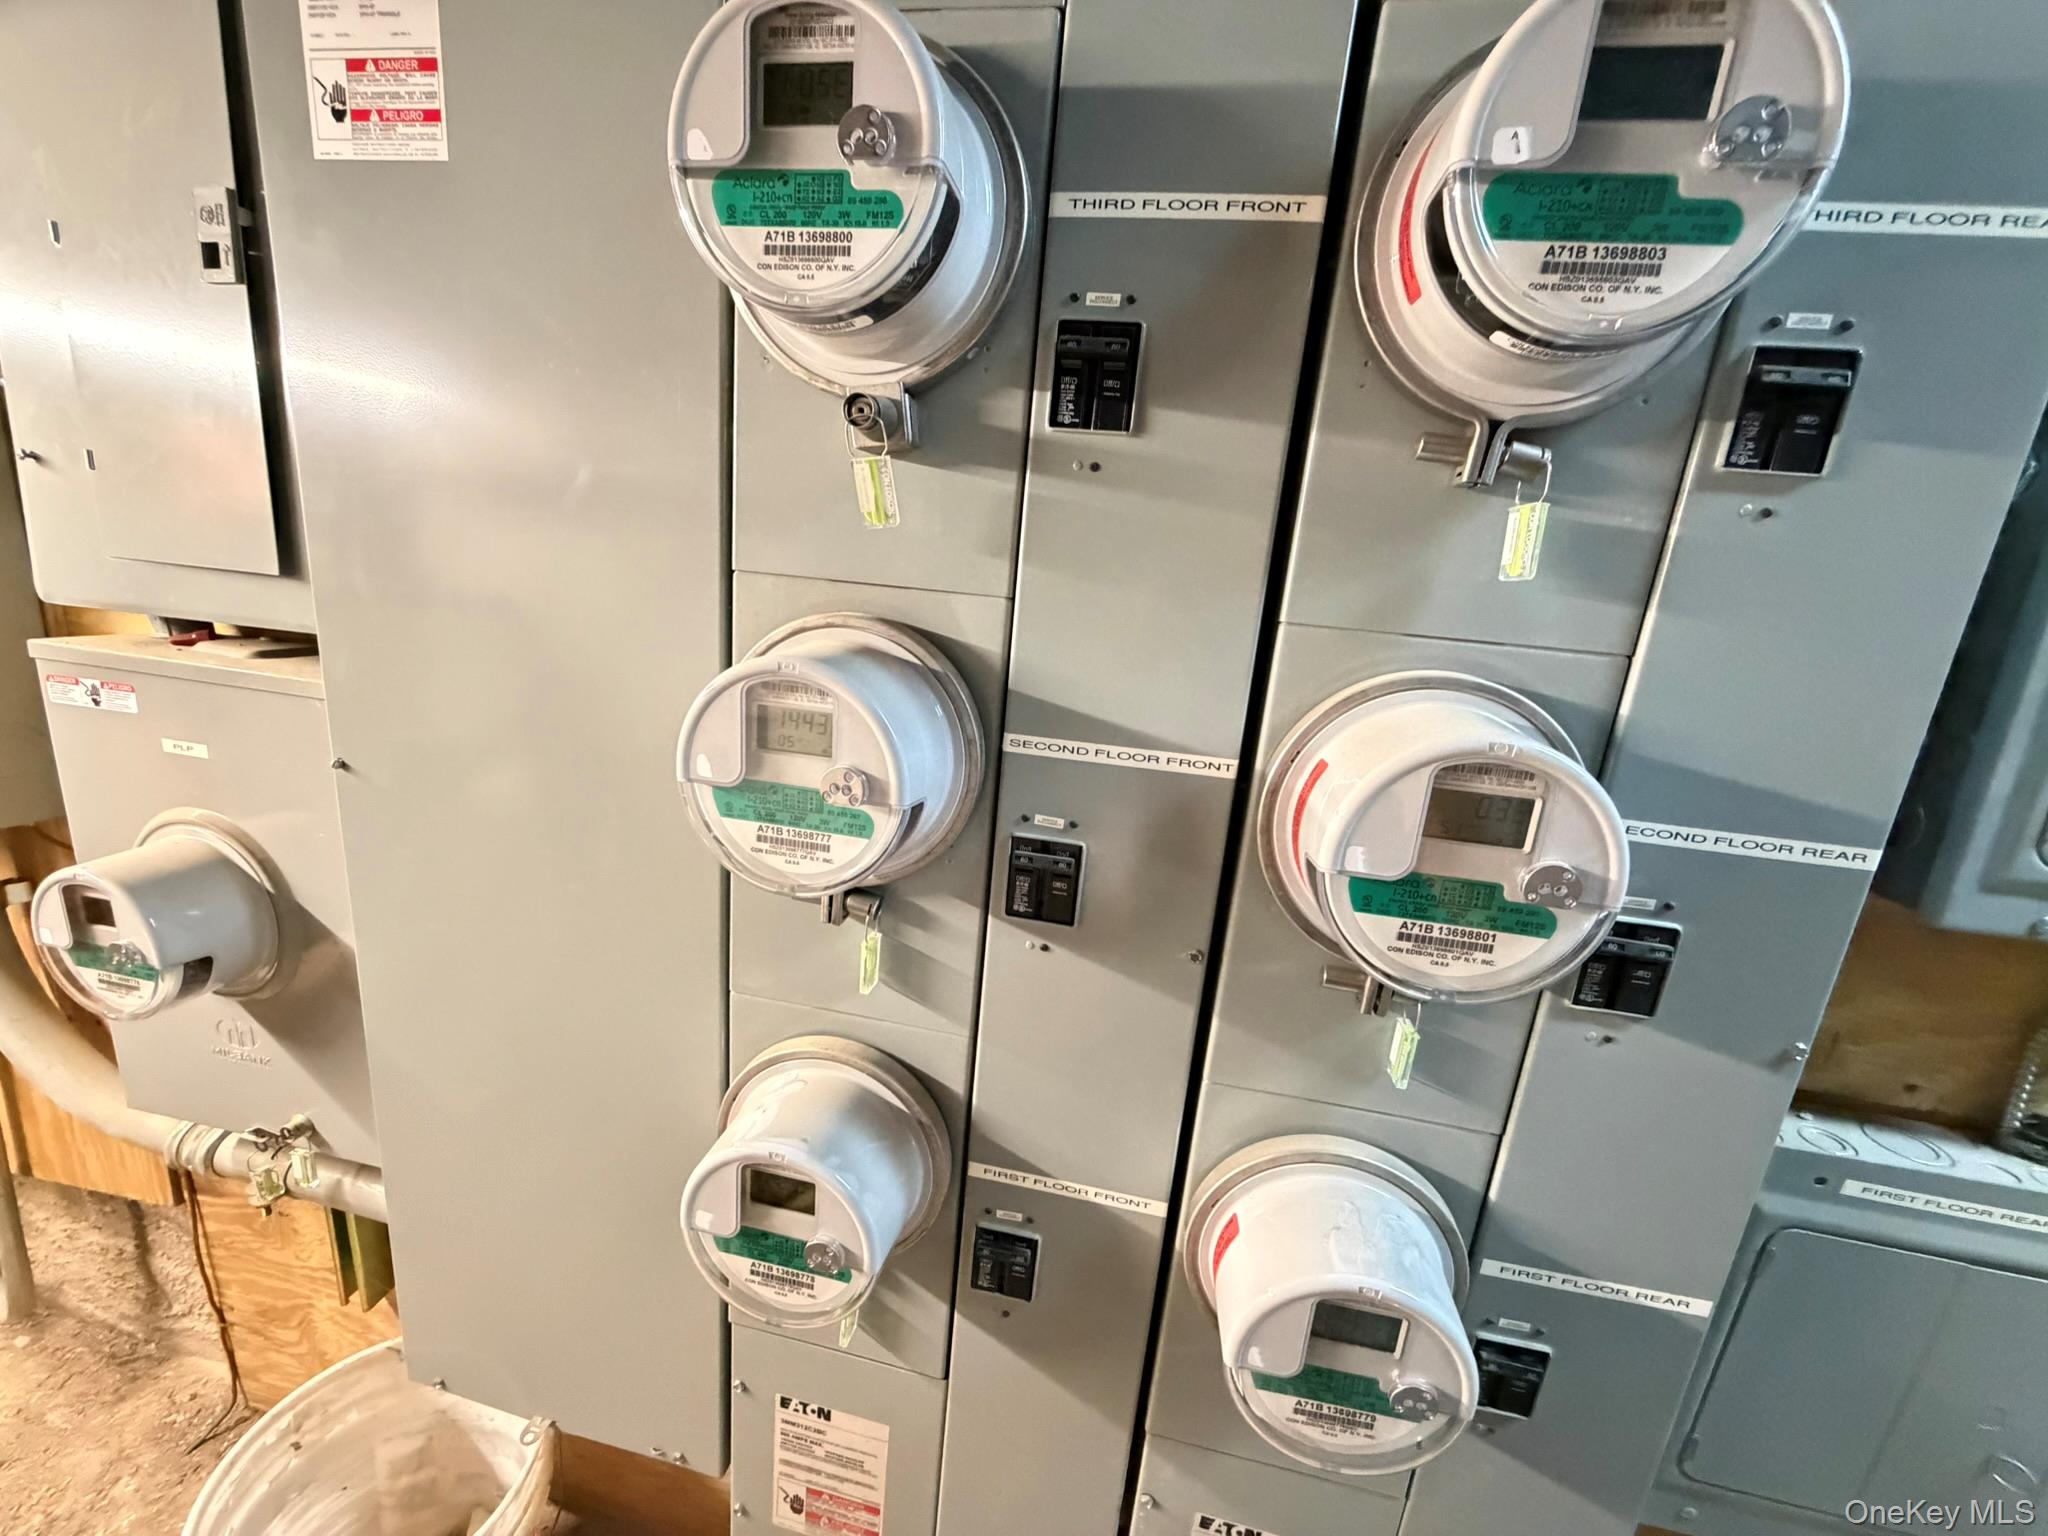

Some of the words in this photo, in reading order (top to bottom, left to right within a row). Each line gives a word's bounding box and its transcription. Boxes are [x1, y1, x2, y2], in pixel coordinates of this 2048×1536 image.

[378, 60, 419, 71] DANGER
[382, 111, 424, 121] PELIGRO
[1069, 198, 1136, 210] THIRD
[1142, 199, 1219, 212] FLOOR
[1226, 200, 1308, 214] FRONT
[1814, 209, 1883, 224] HIRD
[1890, 210, 1990, 227] FLOOR
[2000, 213, 2048, 229] RE
[764, 231, 795, 243] A71B
[799, 231, 853, 243] 13698800
[1545, 245, 1587, 259] A71B
[1592, 246, 1667, 261] 13698803
[757, 263, 772, 271] CON
[774, 263, 800, 271] EDISON
[1528, 282, 1549, 291] CON
[1551, 283, 1586, 292] EDISON
[1608, 285, 1621, 293] OF
[779, 709, 830, 735] 1443
[1009, 738, 1089, 756] SECOND
[1094, 749, 1160, 765] FLOOR
[1166, 757, 1234, 773] FRONT
[757, 825, 784, 836] A71B
[786, 829, 832, 843] 13698777
[750, 846, 765, 855] CON
[765, 848, 787, 857] EDISON
[1625, 824, 1707, 843] ECOND
[1714, 836, 1795, 855] FLOOR
[1801, 847, 1868, 864] REAR
[1400, 921, 1433, 934] A71B
[1438, 926, 1497, 943] 13698801
[1387, 945, 1404, 954] CON
[1406, 948, 1434, 958] EDISON
[1452, 954, 1462, 962] OF
[983, 1168, 1029, 1183] FIRST
[1033, 1178, 1089, 1196] FLOOR
[1094, 1192, 1152, 1209] FRONT
[1861, 1187, 1921, 1203] FIRST
[1924, 1199, 1993, 1218] FLOOR
[750, 1262, 773, 1273] A71B
[1499, 1266, 1557, 1283] FIRST
[1561, 1278, 1629, 1297] FLOOR
[1635, 1291, 1690, 1309] REAR
[779, 1396, 832, 1422] EATON
[1295, 1399, 1323, 1411] A71B
